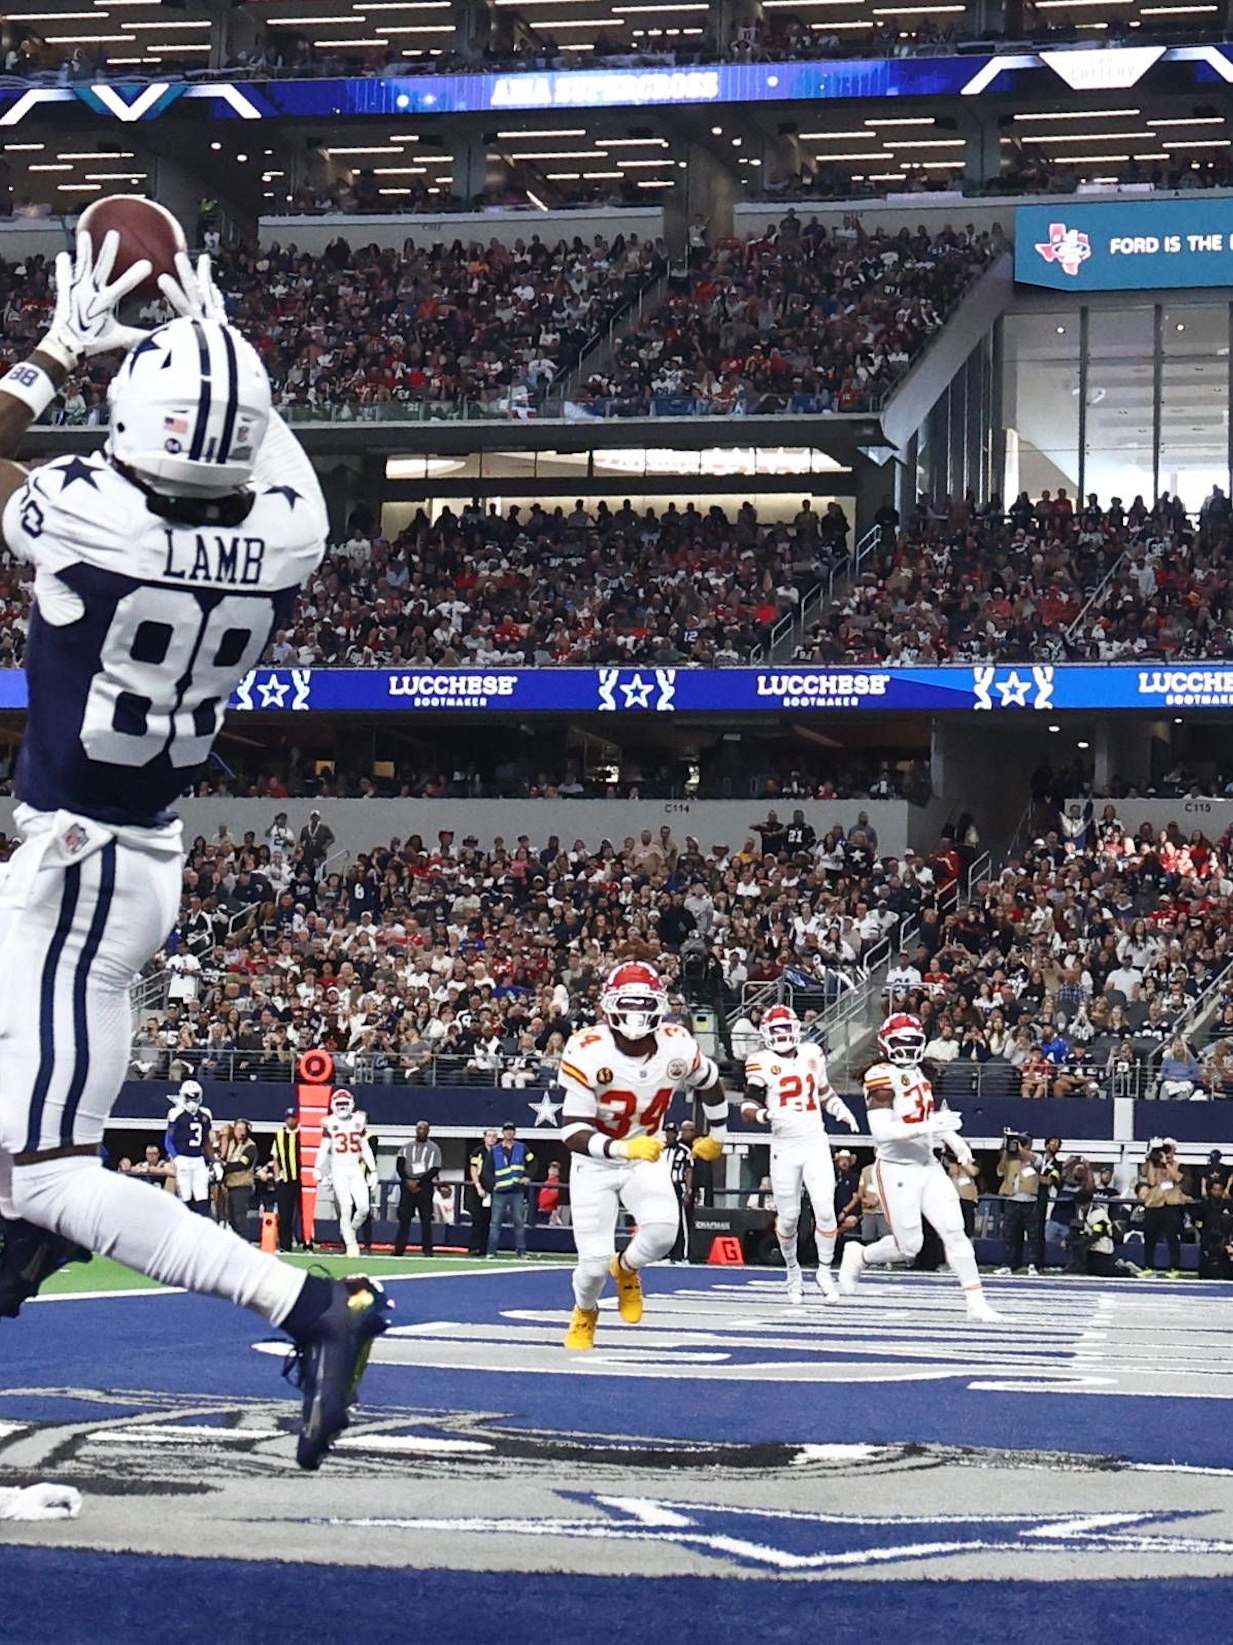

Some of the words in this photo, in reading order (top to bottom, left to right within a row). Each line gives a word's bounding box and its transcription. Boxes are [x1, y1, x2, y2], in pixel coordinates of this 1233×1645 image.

[1110, 236, 1159, 254] FORD
[1164, 235, 1181, 252] IS
[1187, 234, 1223, 252] THE
[163, 529, 266, 585] LAMB
[79, 585, 276, 768] 88
[389, 675, 514, 695] LUCCHESE
[757, 674, 886, 695] LUCCHESE
[413, 697, 487, 707] BOOTMAKER
[782, 696, 859, 707] BOOTMAKER
[665, 804, 689, 813] C114
[1185, 803, 1211, 813] C115
[788, 829, 803, 843] 21
[779, 1074, 817, 1112] 21
[594, 1088, 675, 1139] 34
[188, 1122, 203, 1147] 3
[334, 1133, 362, 1153] 35
[722, 1240, 738, 1260] G
